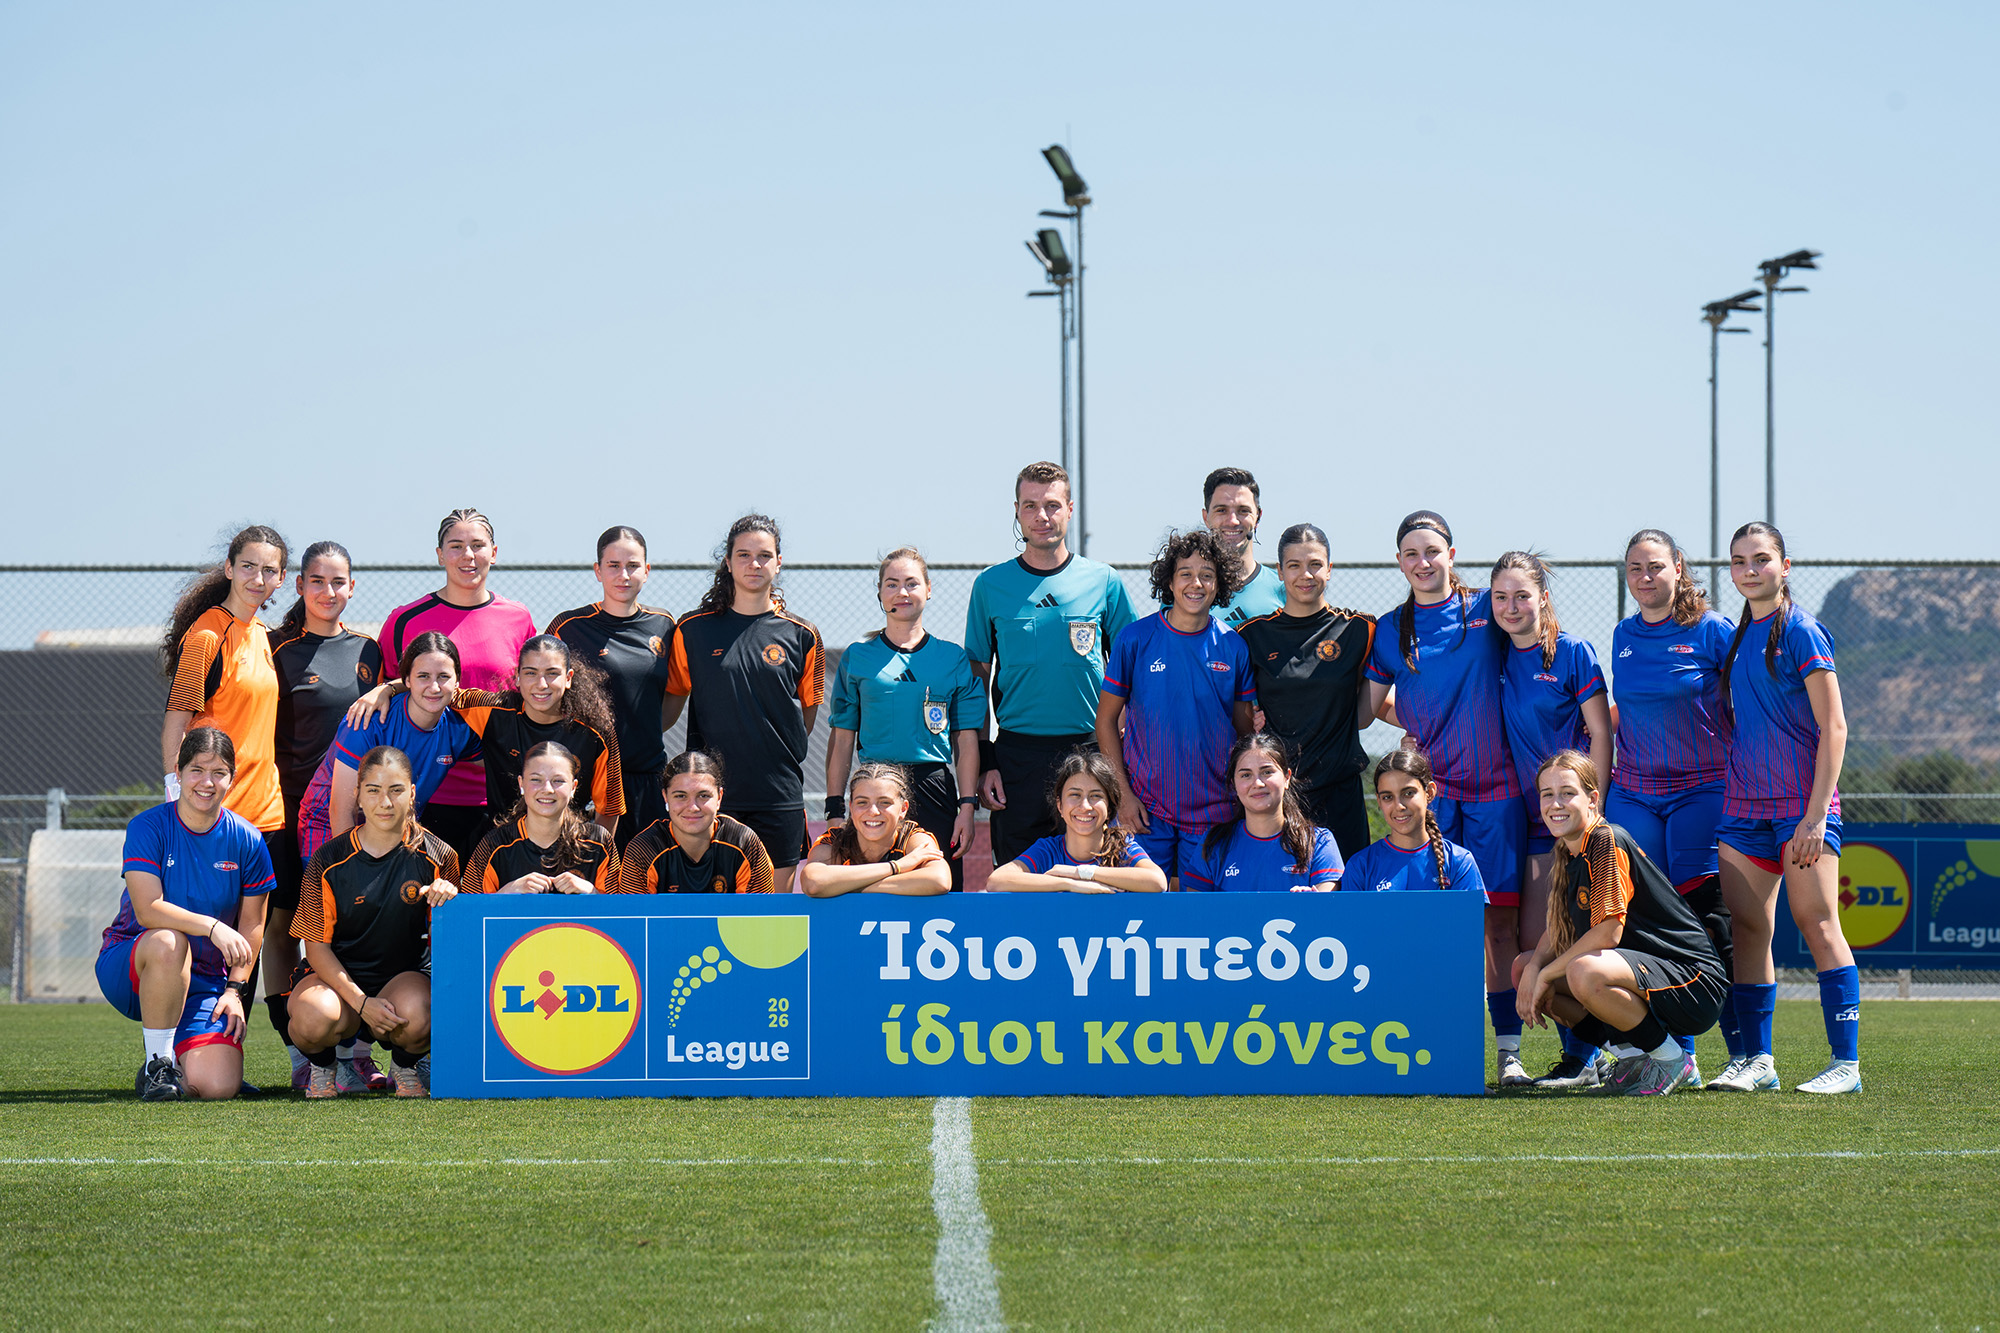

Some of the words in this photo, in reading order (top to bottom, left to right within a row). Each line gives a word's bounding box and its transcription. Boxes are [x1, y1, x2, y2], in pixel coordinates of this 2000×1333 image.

[1149, 663, 1166, 673] CAP
[1225, 869, 1240, 877] CAP
[1376, 882, 1393, 893] CAP
[1838, 875, 1903, 911] iDL
[1929, 921, 2000, 948] Leagu
[859, 918, 1037, 981] Ίδιο
[1058, 918, 1371, 997] γήπεδο,
[768, 998, 790, 1012] 20
[768, 1013, 789, 1028] 26
[881, 1003, 1064, 1065] ίδιοι
[1083, 1004, 1432, 1076] κανόνες.
[667, 1035, 790, 1070] League
